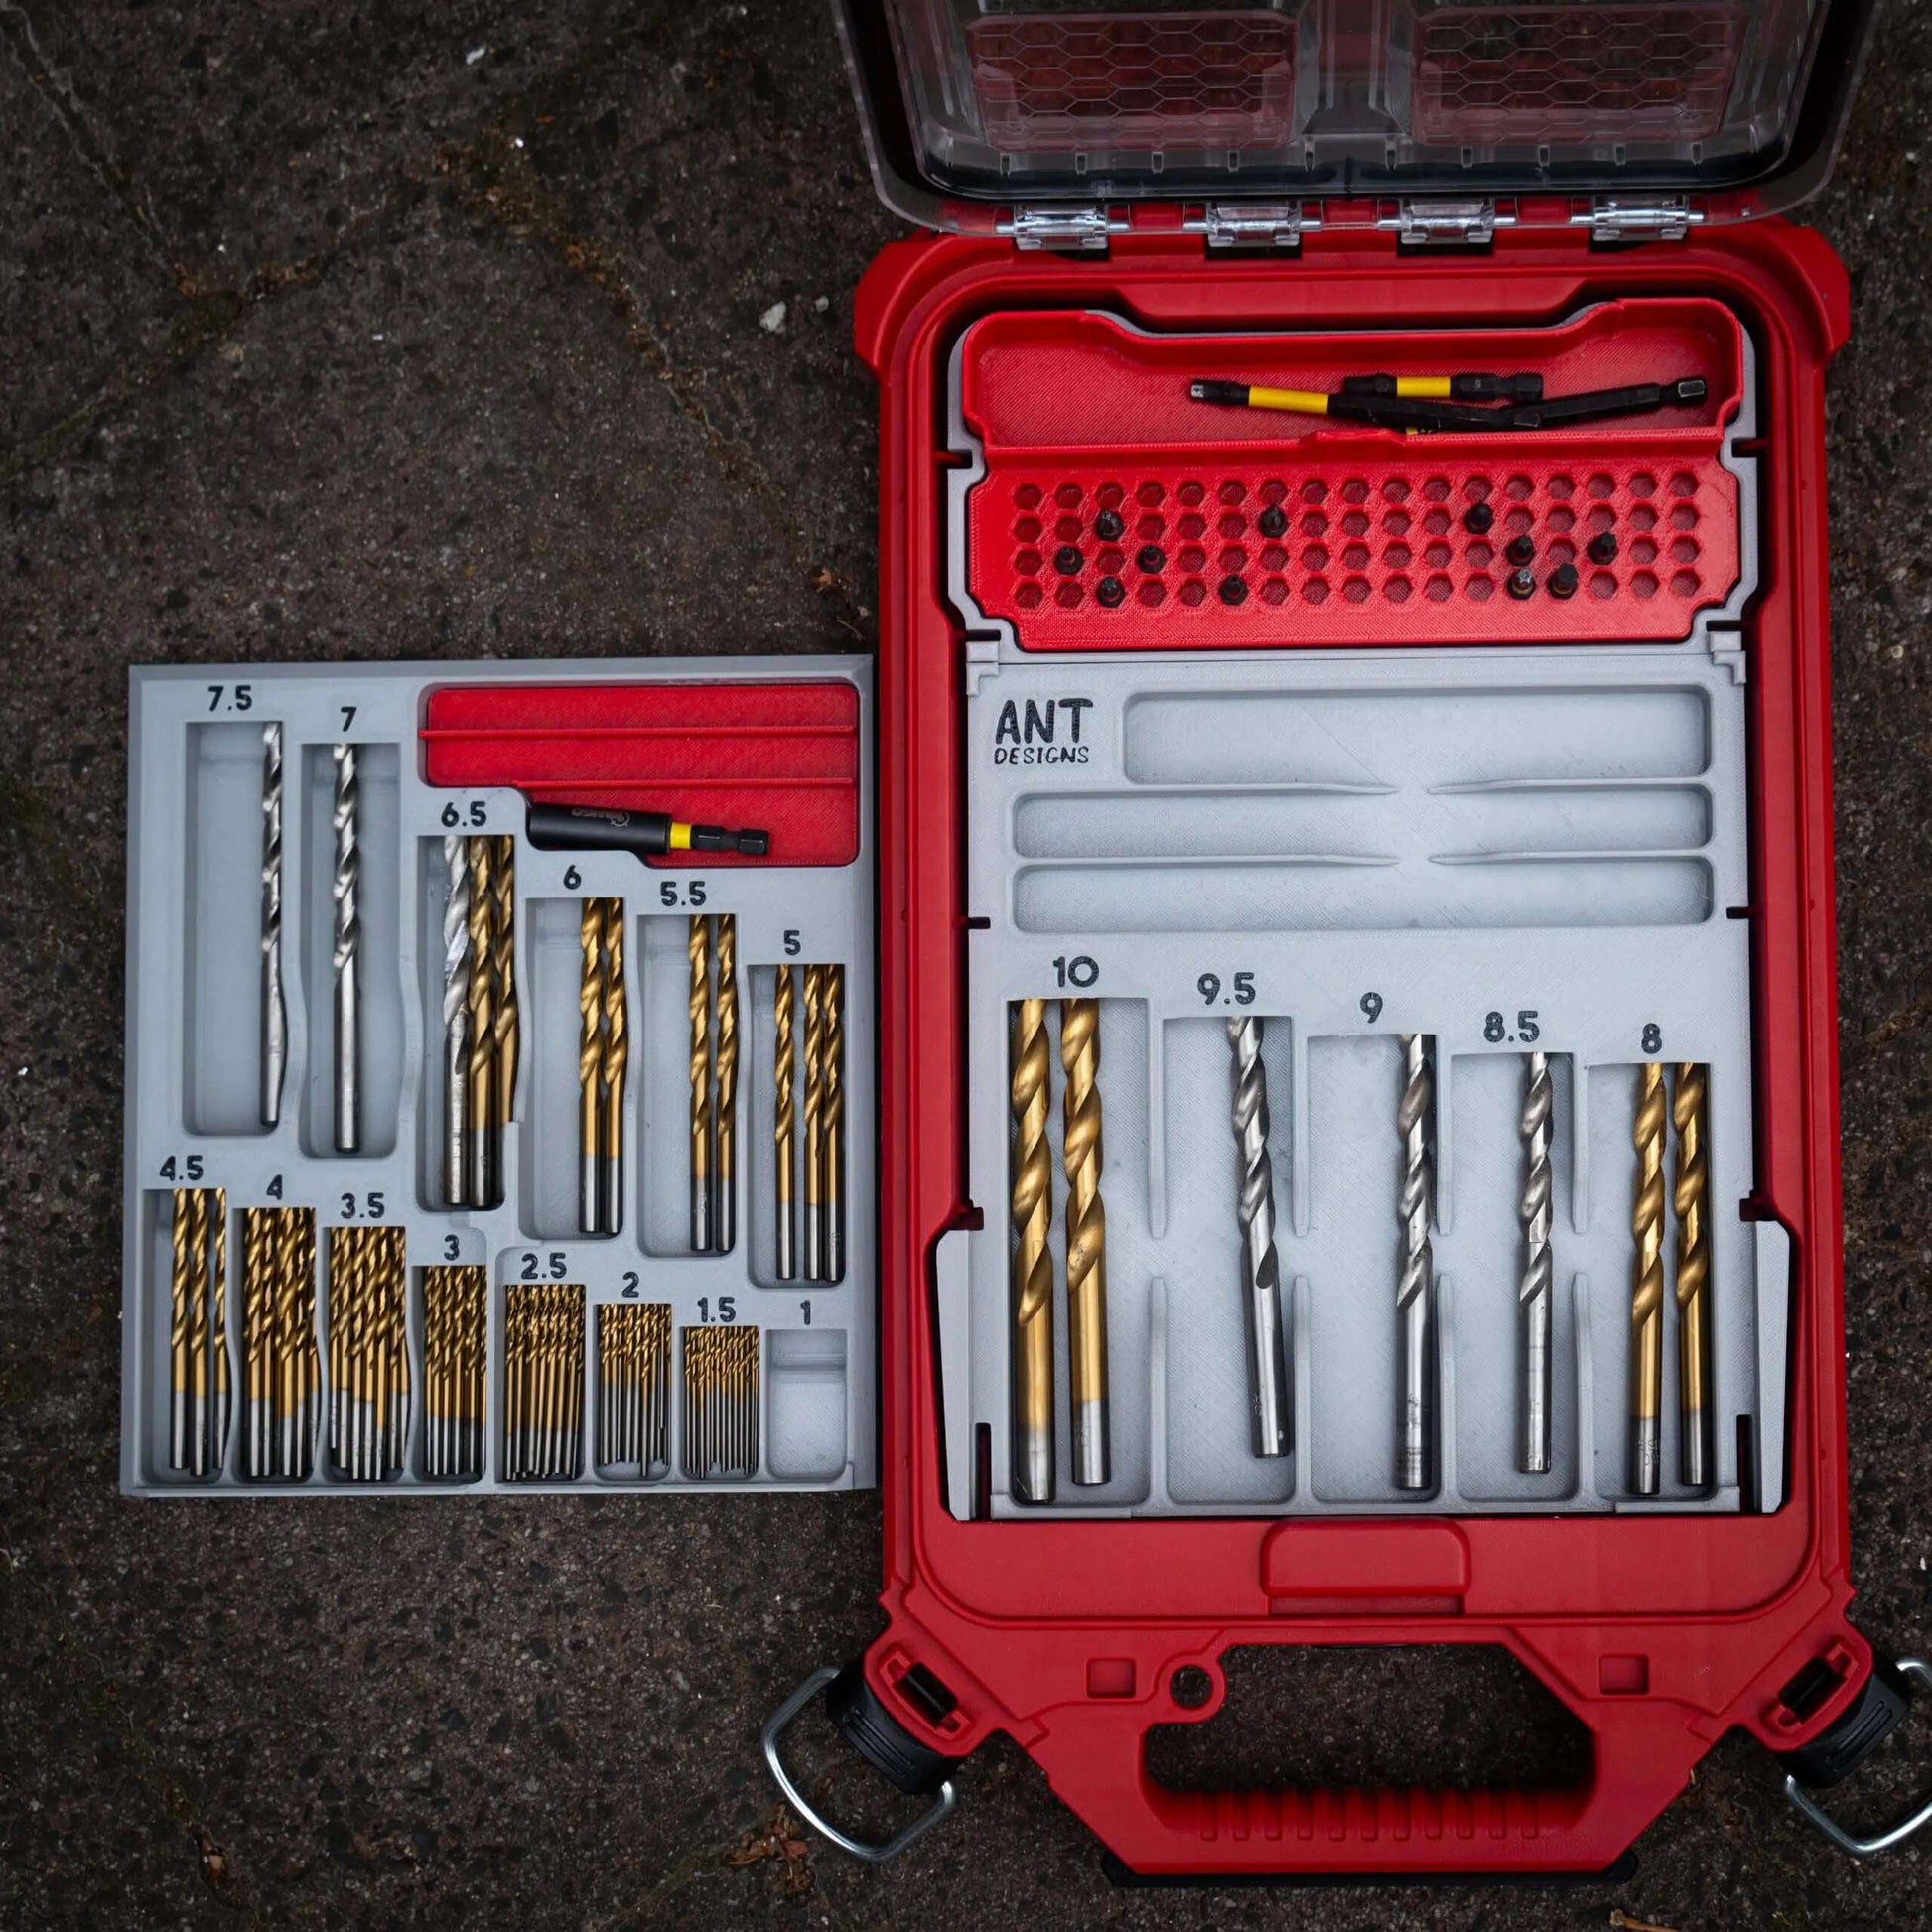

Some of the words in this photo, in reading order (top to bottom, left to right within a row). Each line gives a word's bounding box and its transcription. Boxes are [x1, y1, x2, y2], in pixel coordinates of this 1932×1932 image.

[207, 684, 253, 712] 7.5
[340, 706, 357, 733] 7
[994, 697, 1095, 745] ANT
[994, 746, 1090, 765] DESIGNS
[441, 800, 487, 828] 6.5
[563, 864, 582, 891] 6
[660, 880, 707, 907] 5.5
[783, 929, 801, 956] 5
[1052, 955, 1100, 988] 10
[1197, 972, 1256, 1006] 9.5
[1360, 992, 1383, 1024] 9
[1483, 1010, 1540, 1043] 8.5
[1641, 1023, 1663, 1054] 8
[159, 1154, 204, 1182] 4.5
[266, 1174, 283, 1200] 4
[341, 1192, 385, 1220] 3.5
[444, 1234, 460, 1261] 3
[520, 1252, 567, 1280] 2.5
[621, 1271, 639, 1298] 2
[697, 1296, 737, 1323] 1.5
[800, 1300, 811, 1325] 1
